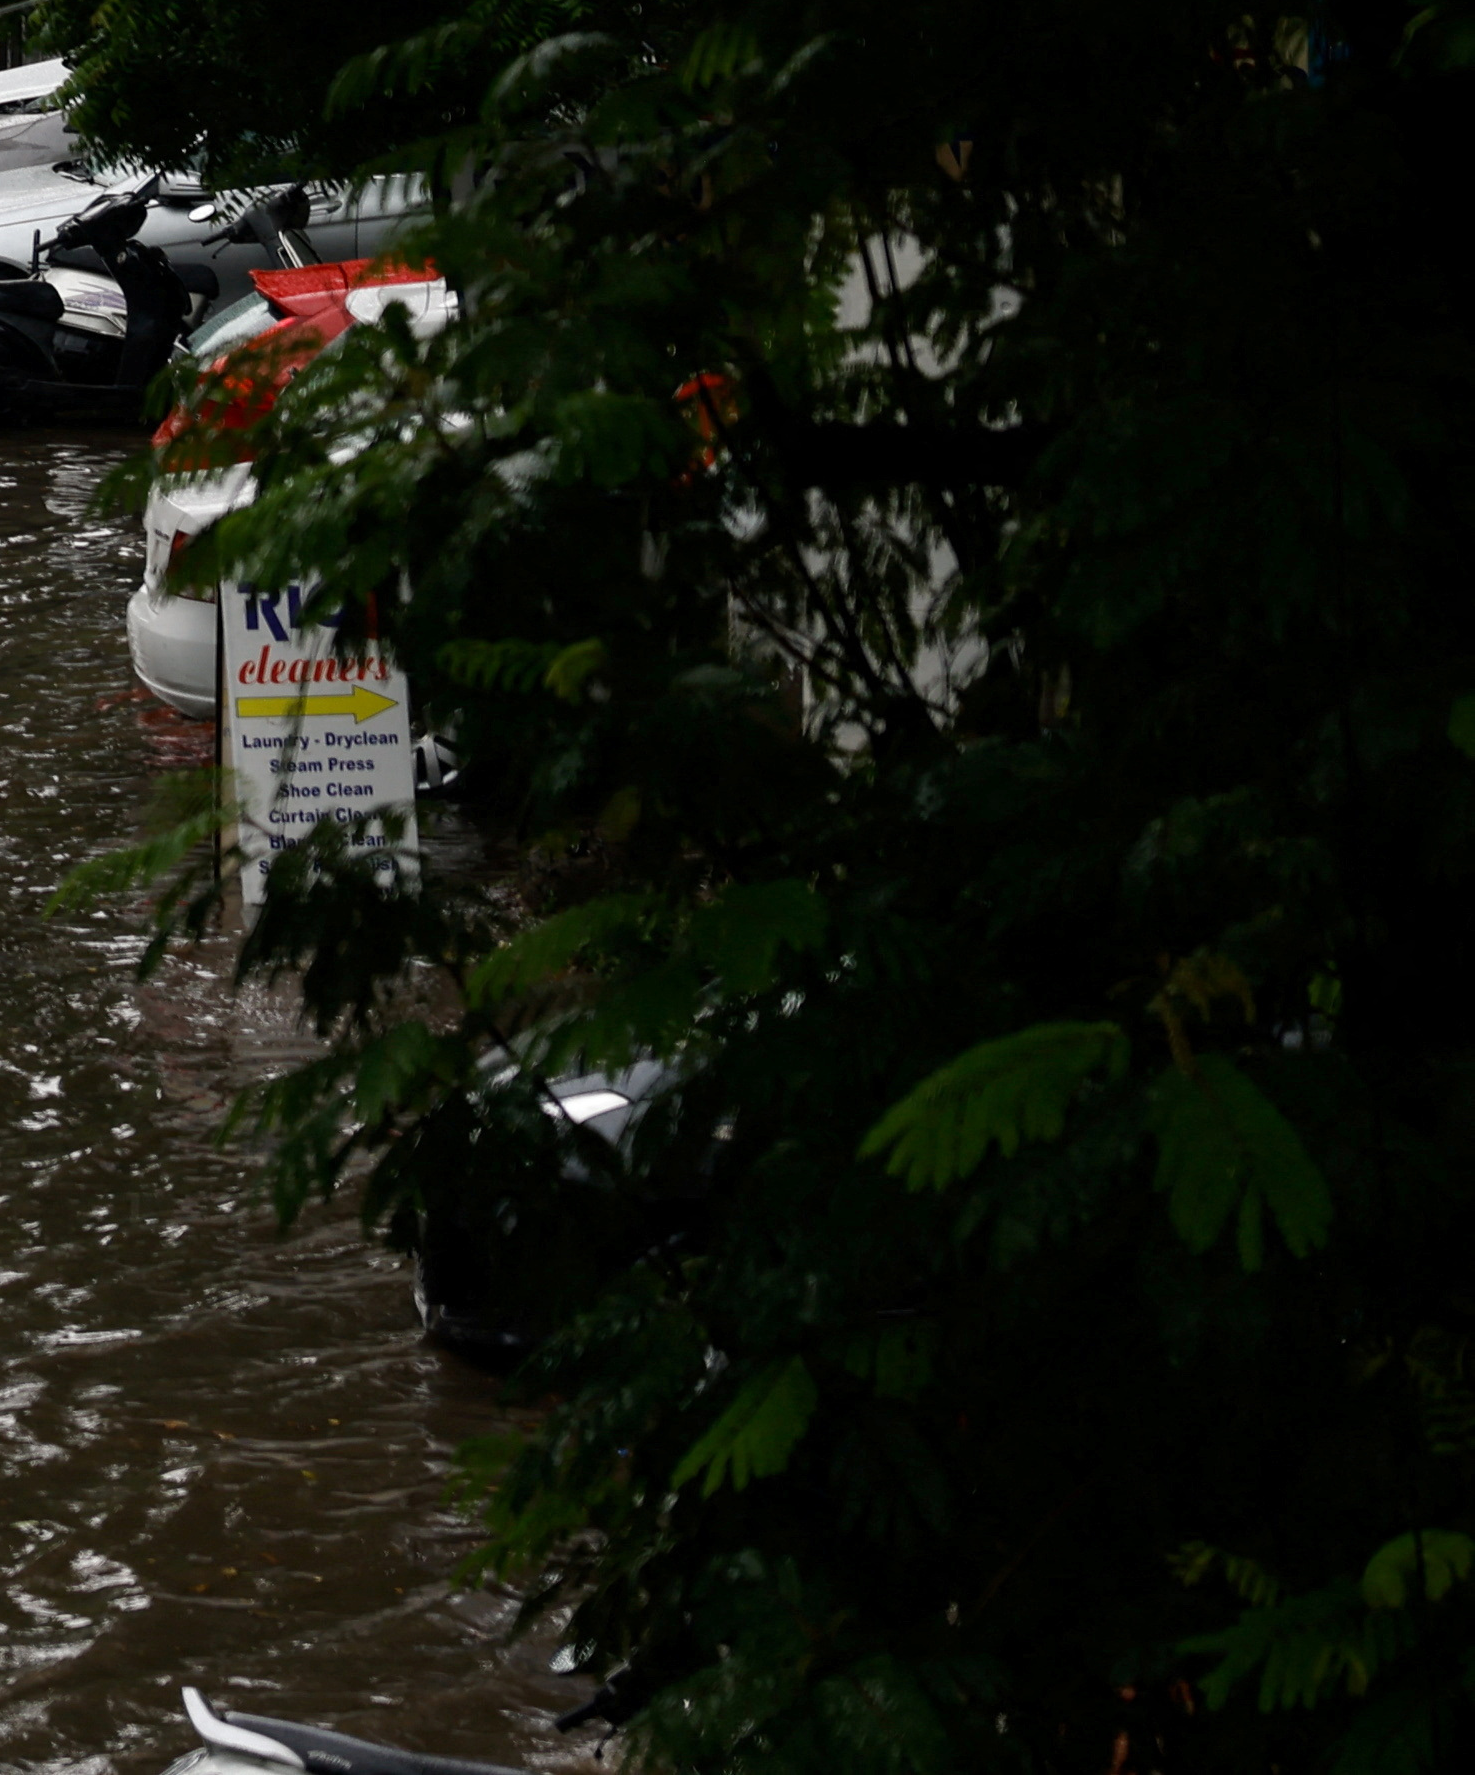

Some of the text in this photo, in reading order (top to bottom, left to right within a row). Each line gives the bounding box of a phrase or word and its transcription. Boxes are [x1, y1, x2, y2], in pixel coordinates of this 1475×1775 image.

[238, 644, 387, 684] cleaners
[325, 731, 398, 749] Dryclean
[269, 757, 375, 773] Seam Press
[279, 782, 373, 797] Shoe Clean
